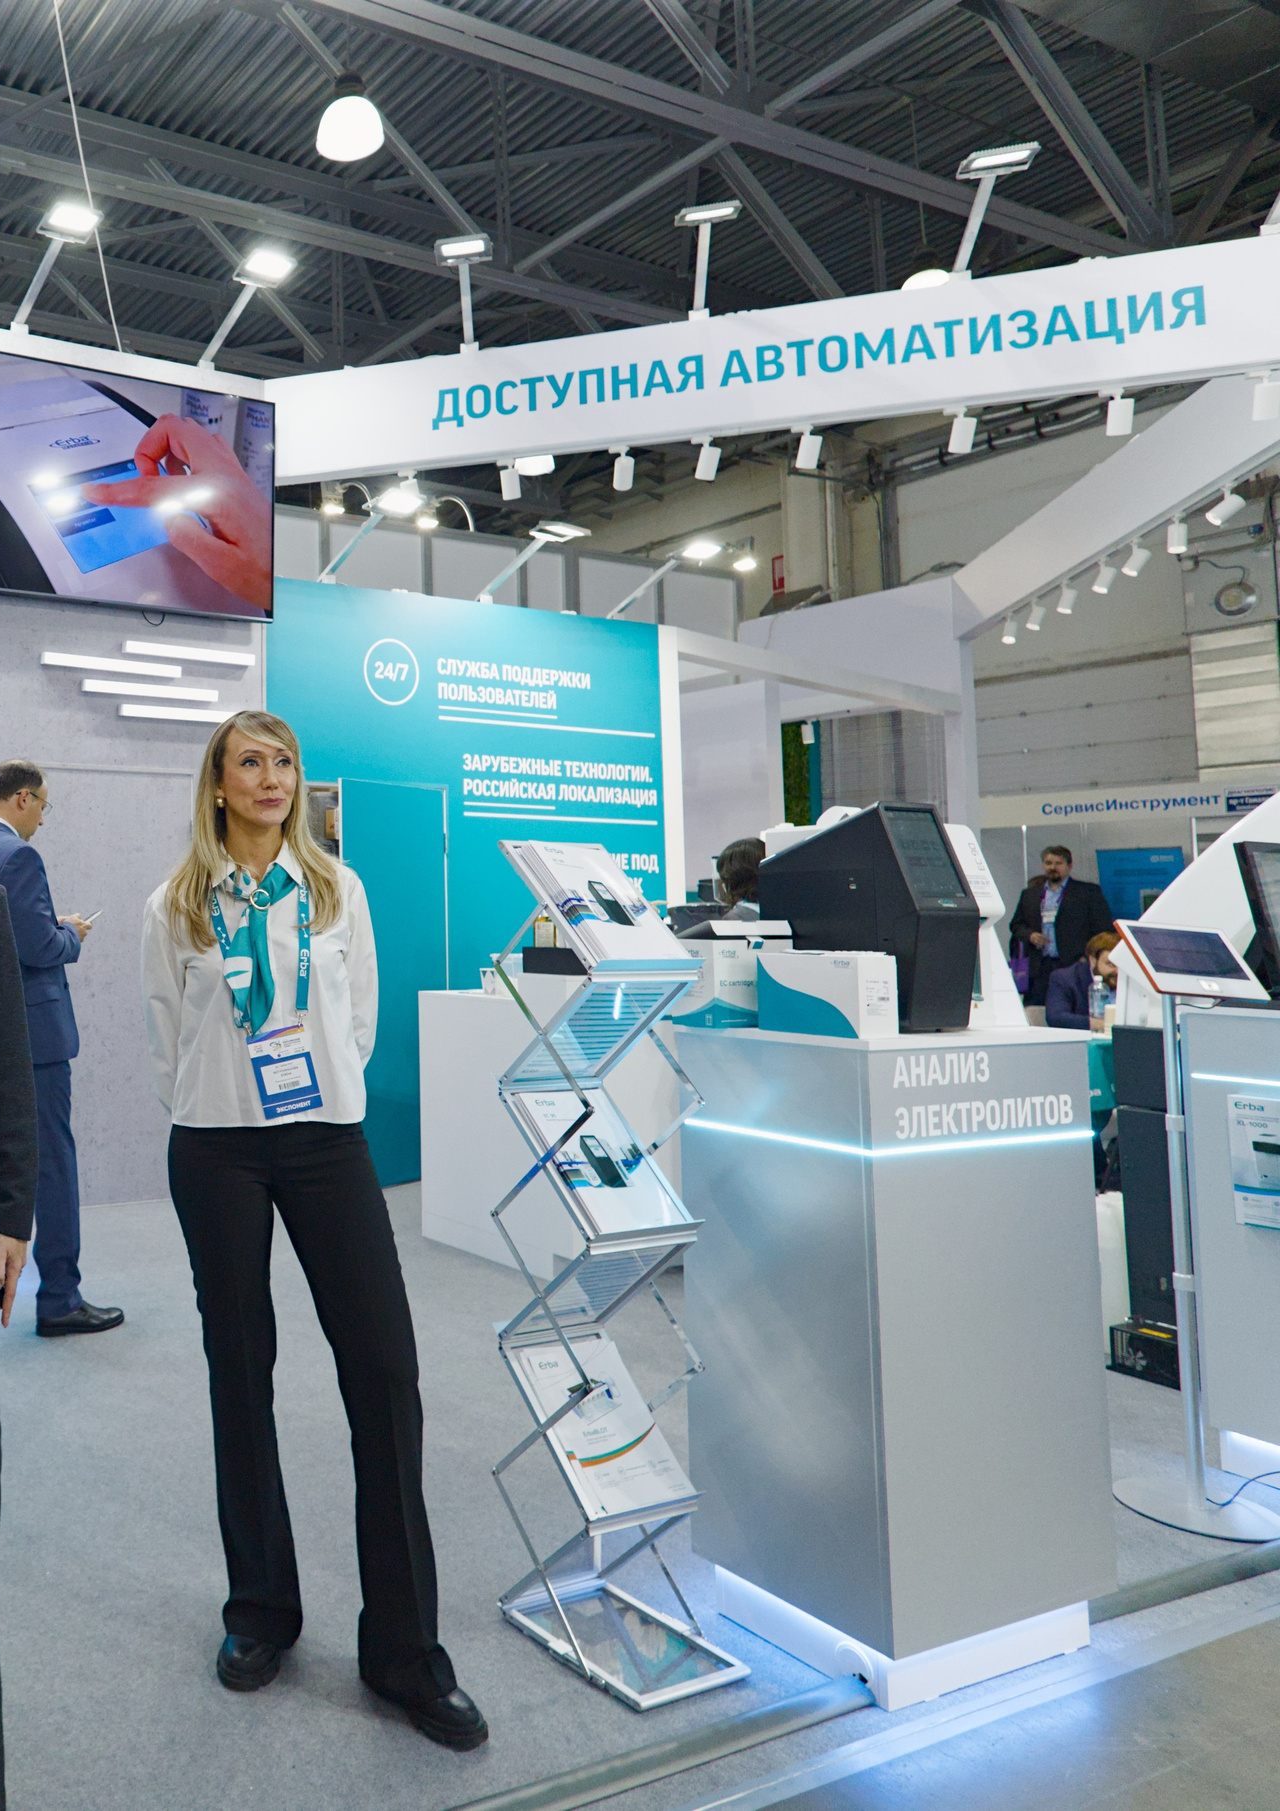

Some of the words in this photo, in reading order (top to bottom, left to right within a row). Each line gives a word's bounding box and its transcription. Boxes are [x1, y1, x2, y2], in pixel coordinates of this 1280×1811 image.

[431, 354, 706, 430] ДОСТУПНАЯ
[720, 285, 1206, 388] АВТОМАТИЗАЦИЯ
[374, 661, 409, 682] 24/7
[437, 657, 500, 681] СЛУЖБА
[502, 664, 590, 690] ПОДДЕРЖКИ
[437, 682, 557, 710] ПОЛЬЗОВАТЕЛЕЙ
[462, 753, 562, 778] ЗАРУБЕЖНЫЕ
[564, 760, 653, 783] ТЕХНОЛОГИИ.
[463, 778, 556, 800] РОССИЙСКАЯ
[558, 782, 657, 808] ЛОКАЛИЗАЦИЯ
[1041, 794, 1222, 817] СервисИнструмент
[631, 854, 659, 874] ПОД
[300, 949, 310, 977] Erba
[729, 979, 753, 987] cartridge
[893, 1051, 990, 1089] АНАЛИЗ
[276, 1100, 311, 1114] ЭКСПОНЕНТ
[895, 1094, 1073, 1140] ЭЛЕКТРОЛИТОВ
[1234, 1101, 1264, 1111] Erba
[538, 1360, 559, 1370] Erba
